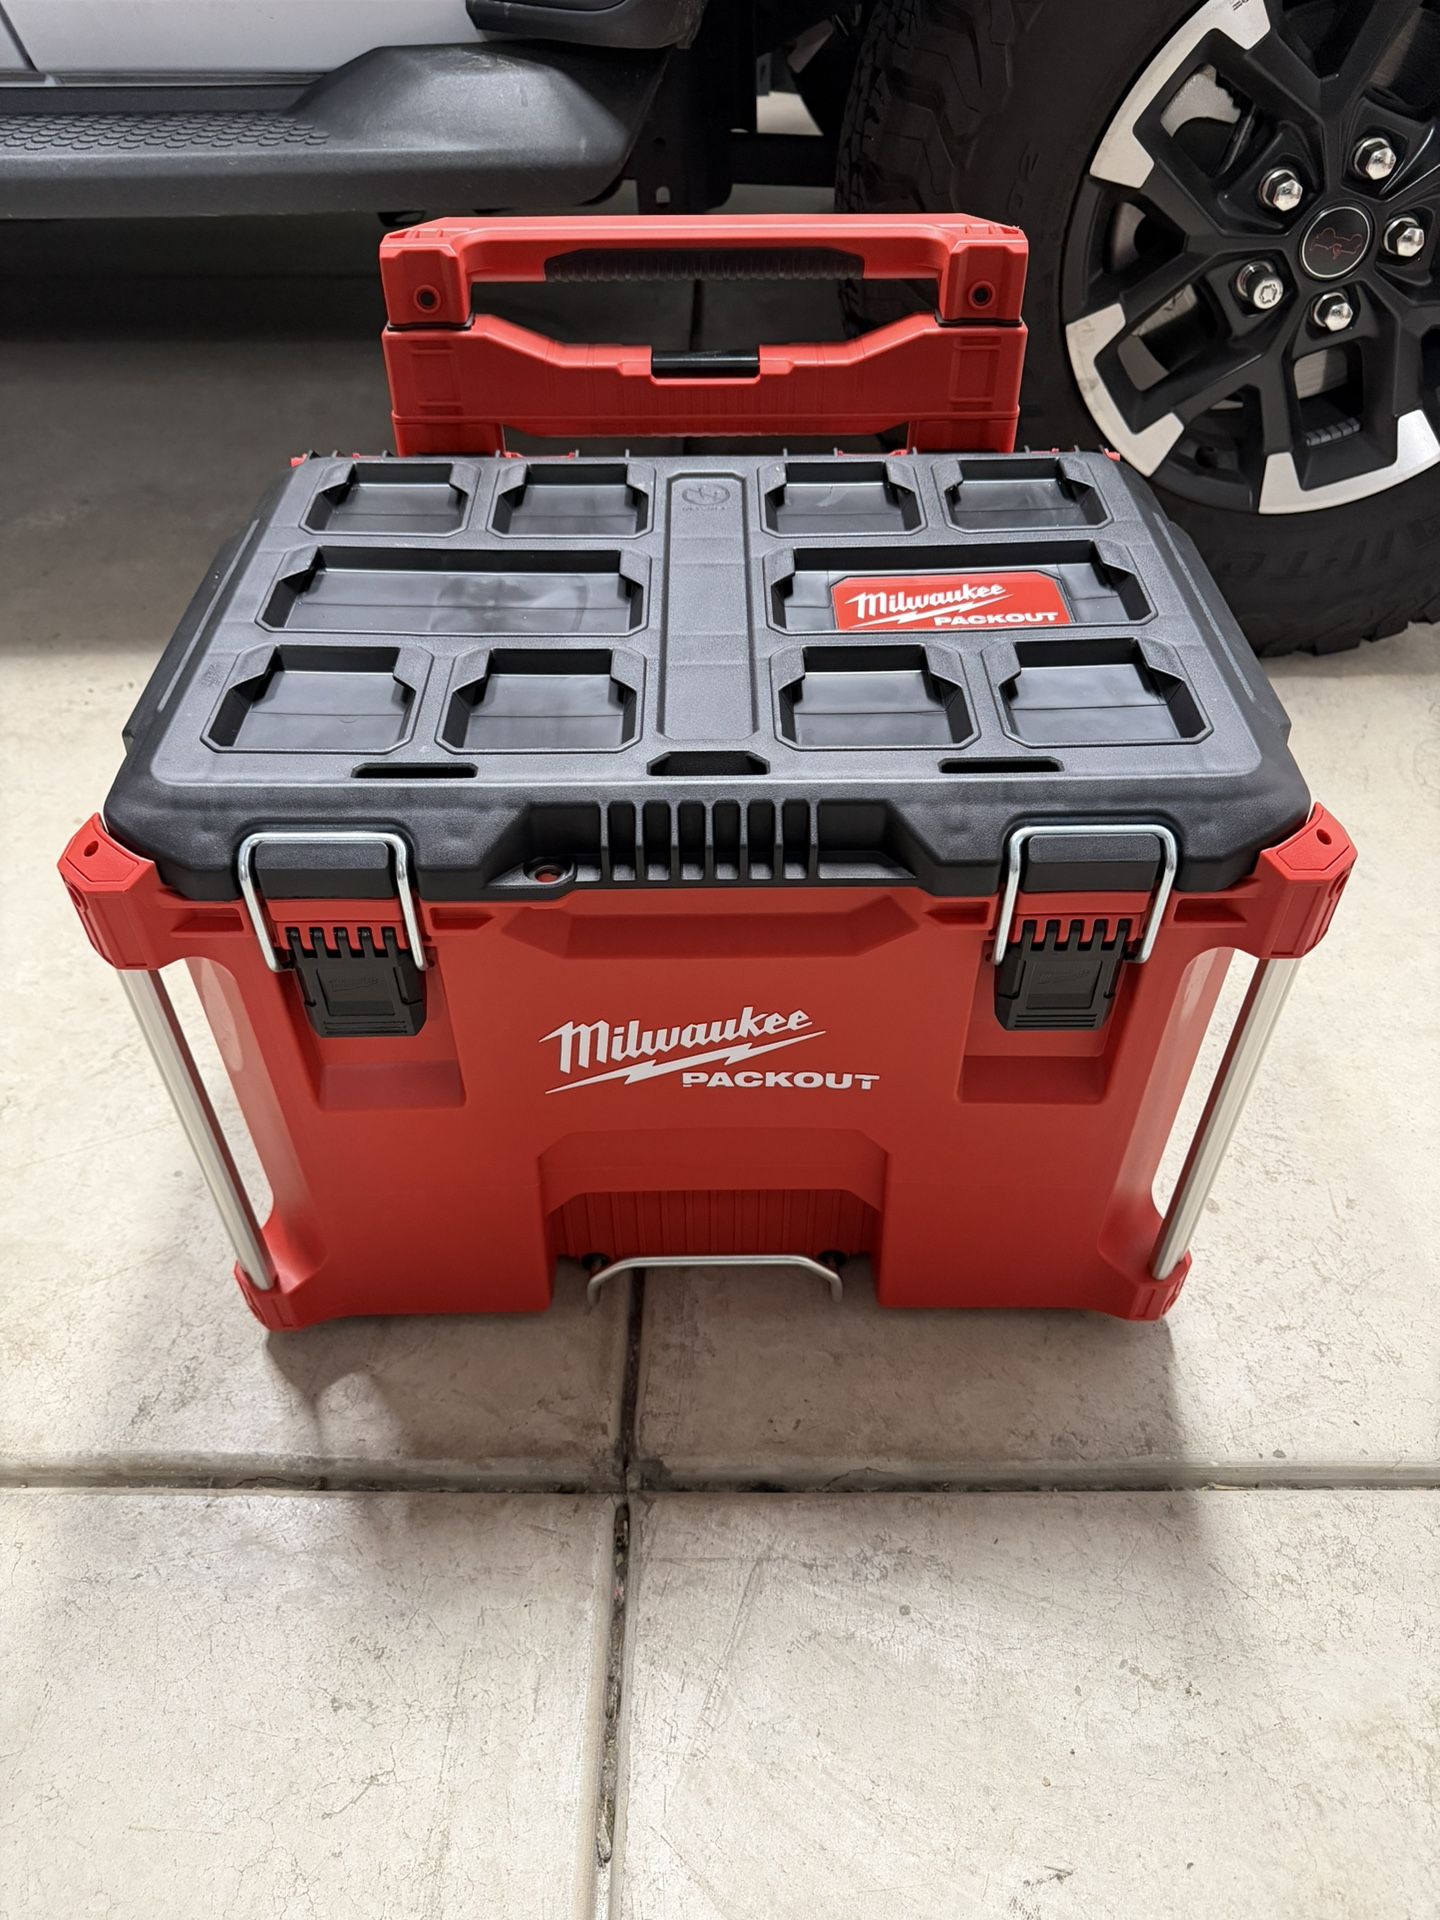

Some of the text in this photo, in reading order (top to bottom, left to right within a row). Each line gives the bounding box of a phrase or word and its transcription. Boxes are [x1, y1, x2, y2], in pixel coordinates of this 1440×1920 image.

[844, 583, 1007, 619] Milwaukee
[934, 611, 1058, 627] PACKOUT
[538, 1006, 813, 1074] Milwaukee
[682, 1072, 880, 1090] PACKOUT
